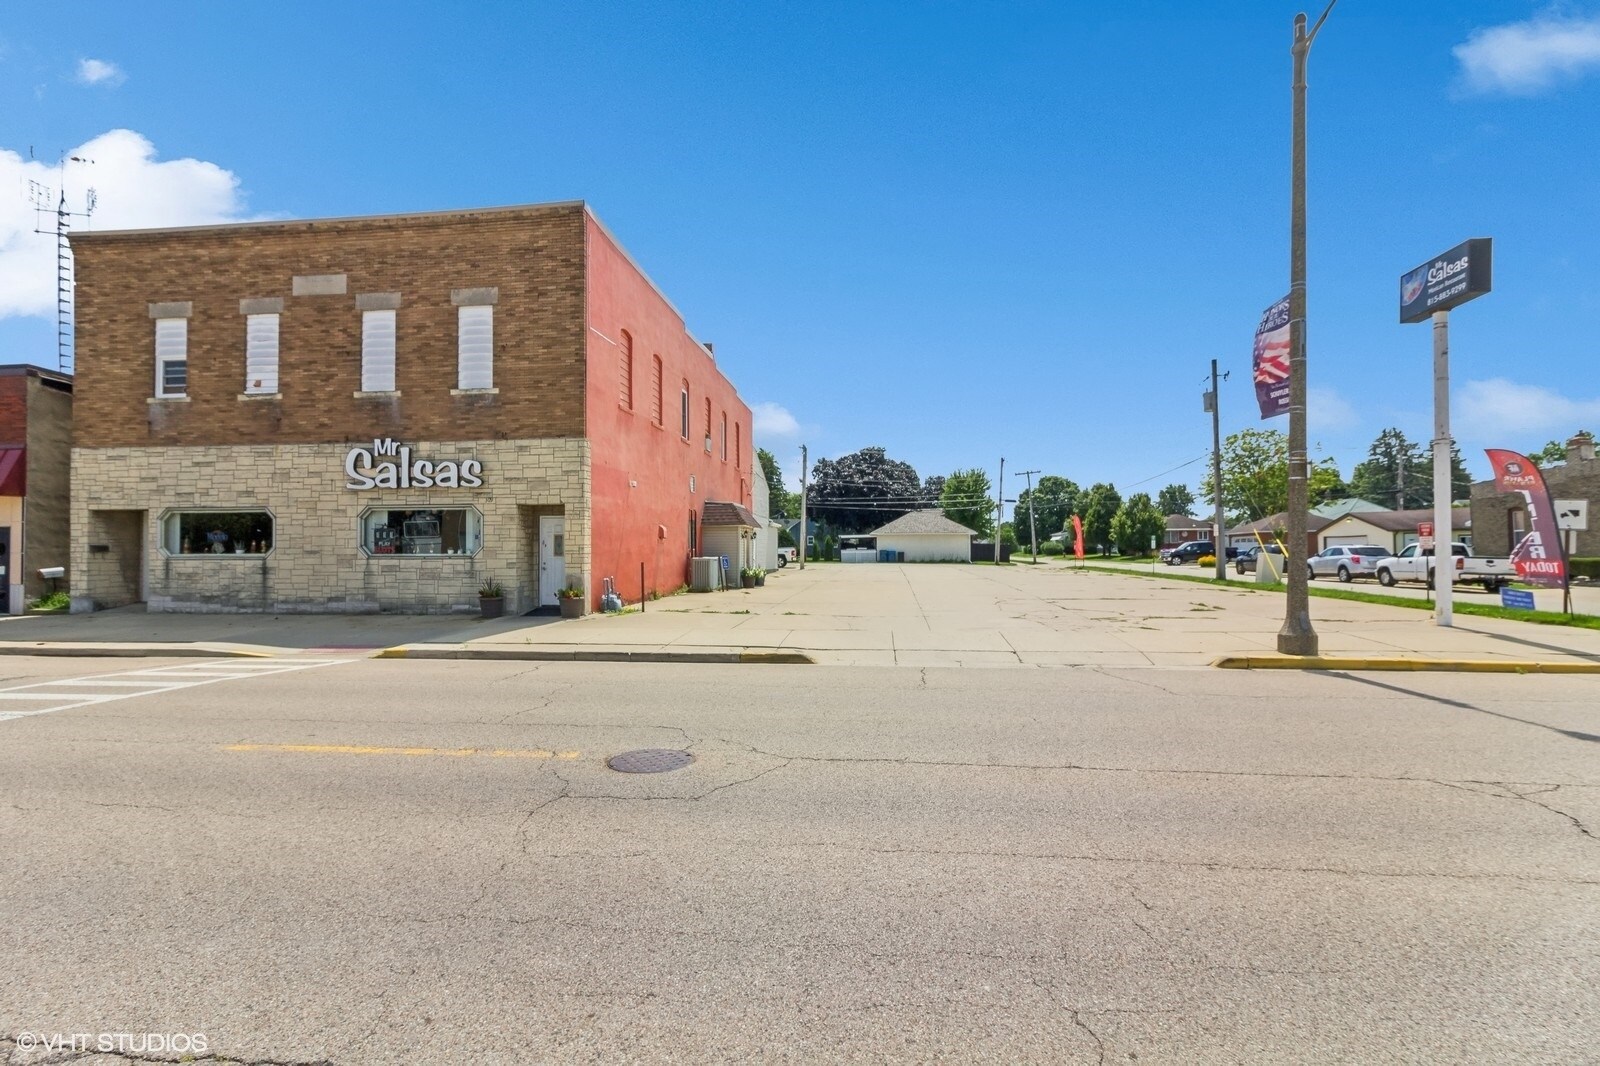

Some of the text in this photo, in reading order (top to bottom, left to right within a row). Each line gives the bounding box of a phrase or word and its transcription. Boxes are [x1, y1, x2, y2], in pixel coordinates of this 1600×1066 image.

[1427, 257, 1468, 286] Salsas
[373, 438, 401, 457] Mr
[345, 447, 483, 490] Salsas
